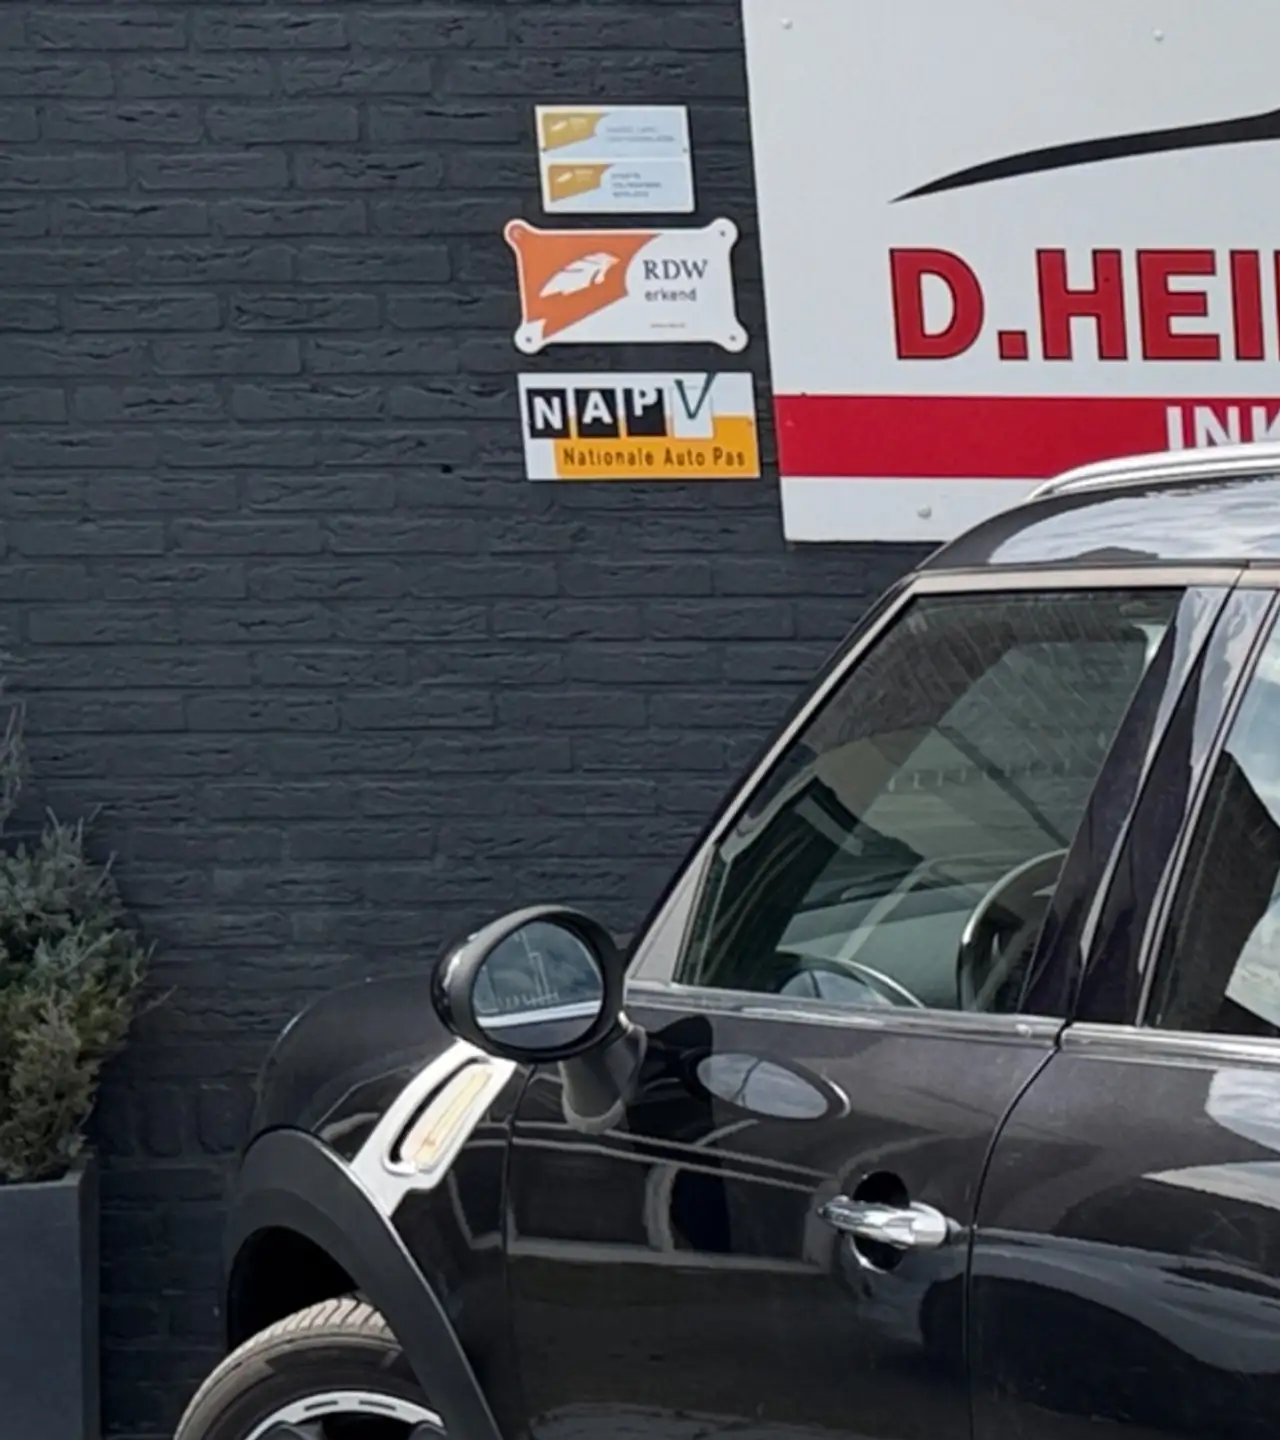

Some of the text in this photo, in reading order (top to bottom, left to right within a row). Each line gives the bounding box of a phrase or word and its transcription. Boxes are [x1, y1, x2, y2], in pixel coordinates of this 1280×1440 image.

[642, 258, 708, 280] RDW
[645, 287, 697, 302] erkend
[563, 446, 746, 467] Nationale Auto Pas
